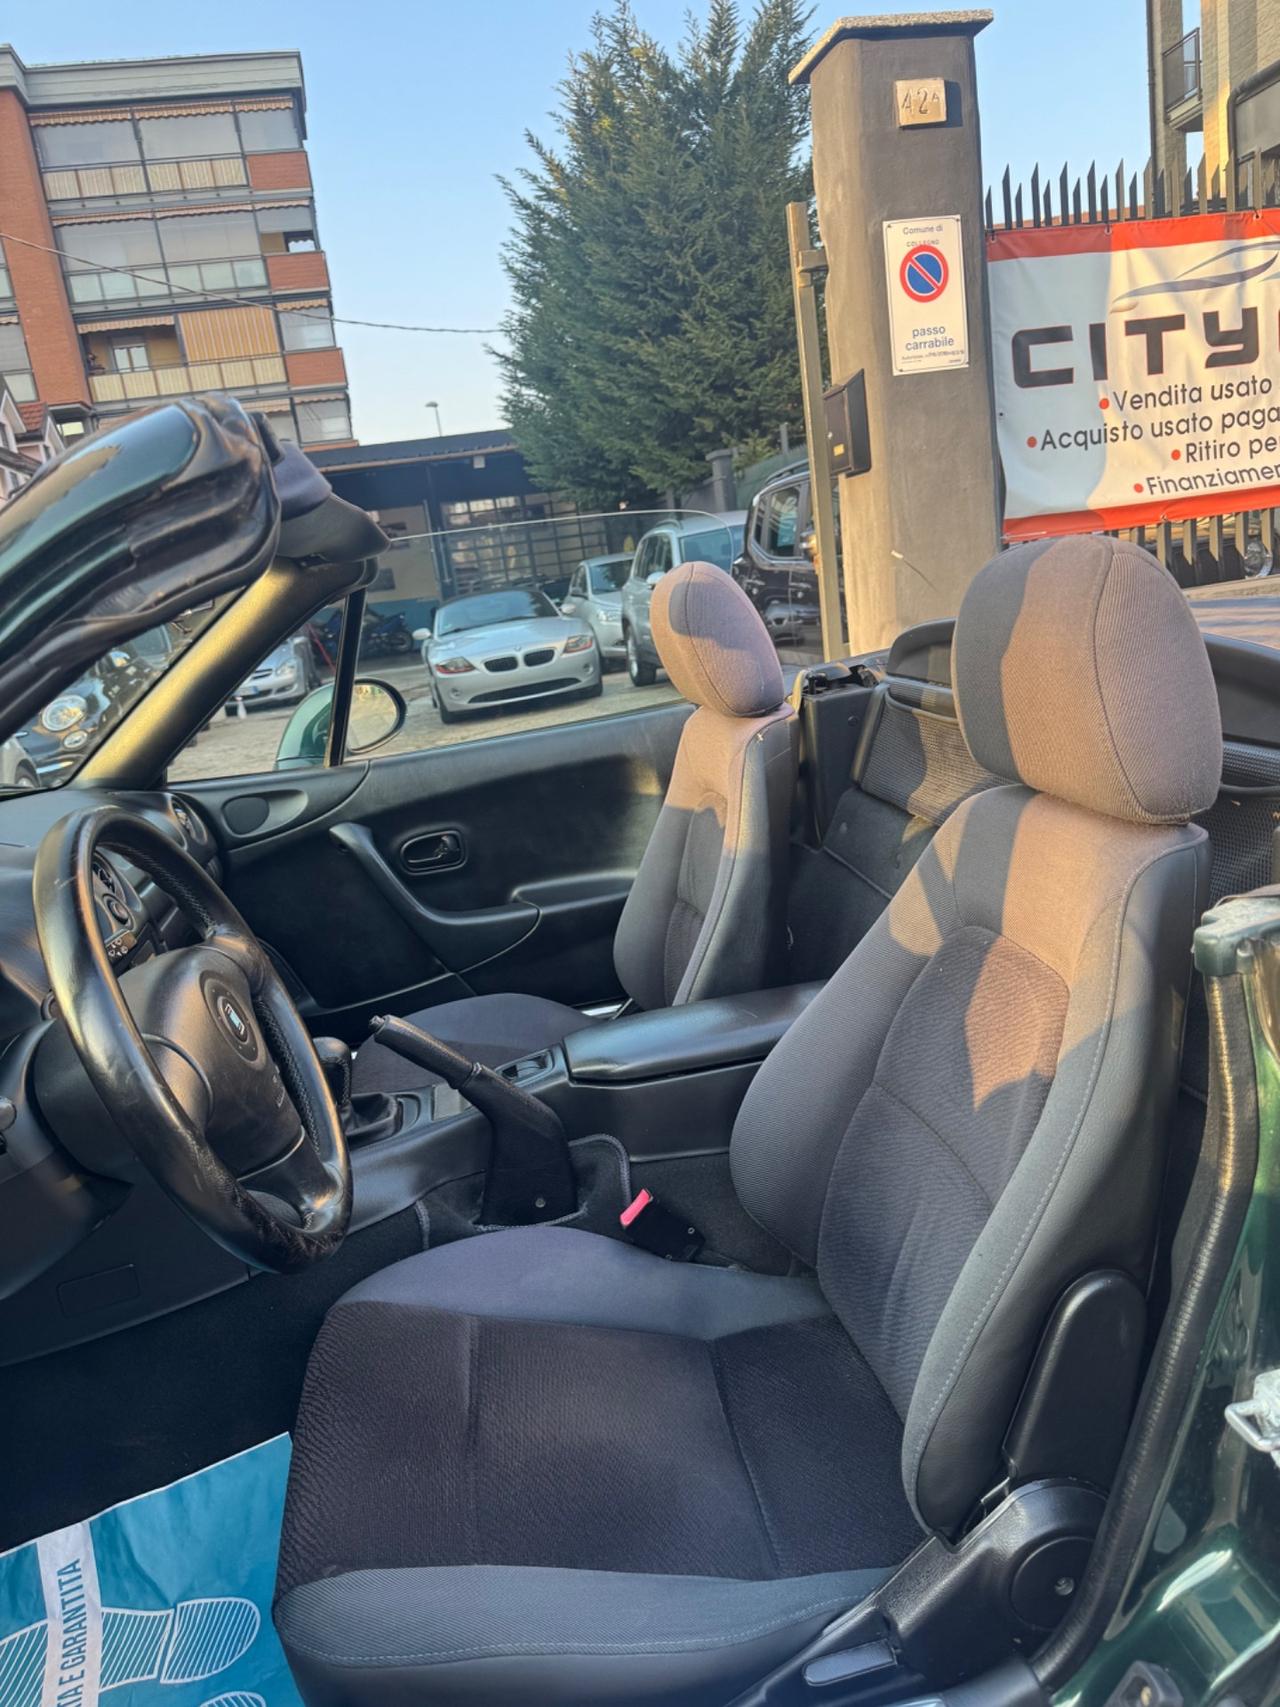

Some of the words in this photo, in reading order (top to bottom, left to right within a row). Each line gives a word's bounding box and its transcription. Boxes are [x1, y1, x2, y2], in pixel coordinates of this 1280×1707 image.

[903, 226, 934, 235] Comune
[905, 337, 954, 351] carrabile
[912, 326, 946, 339] passo
[1011, 306, 1280, 389] CITY
[1113, 385, 1202, 411] Vendita
[1210, 375, 1272, 401] usato
[1040, 420, 1144, 451] Acquisto
[1151, 411, 1213, 438] usato
[1185, 439, 1240, 463] Ritiro
[1249, 436, 1280, 459] pe
[57, 1558, 87, 1671] GARANTITA
[59, 1669, 85, 1686] E
